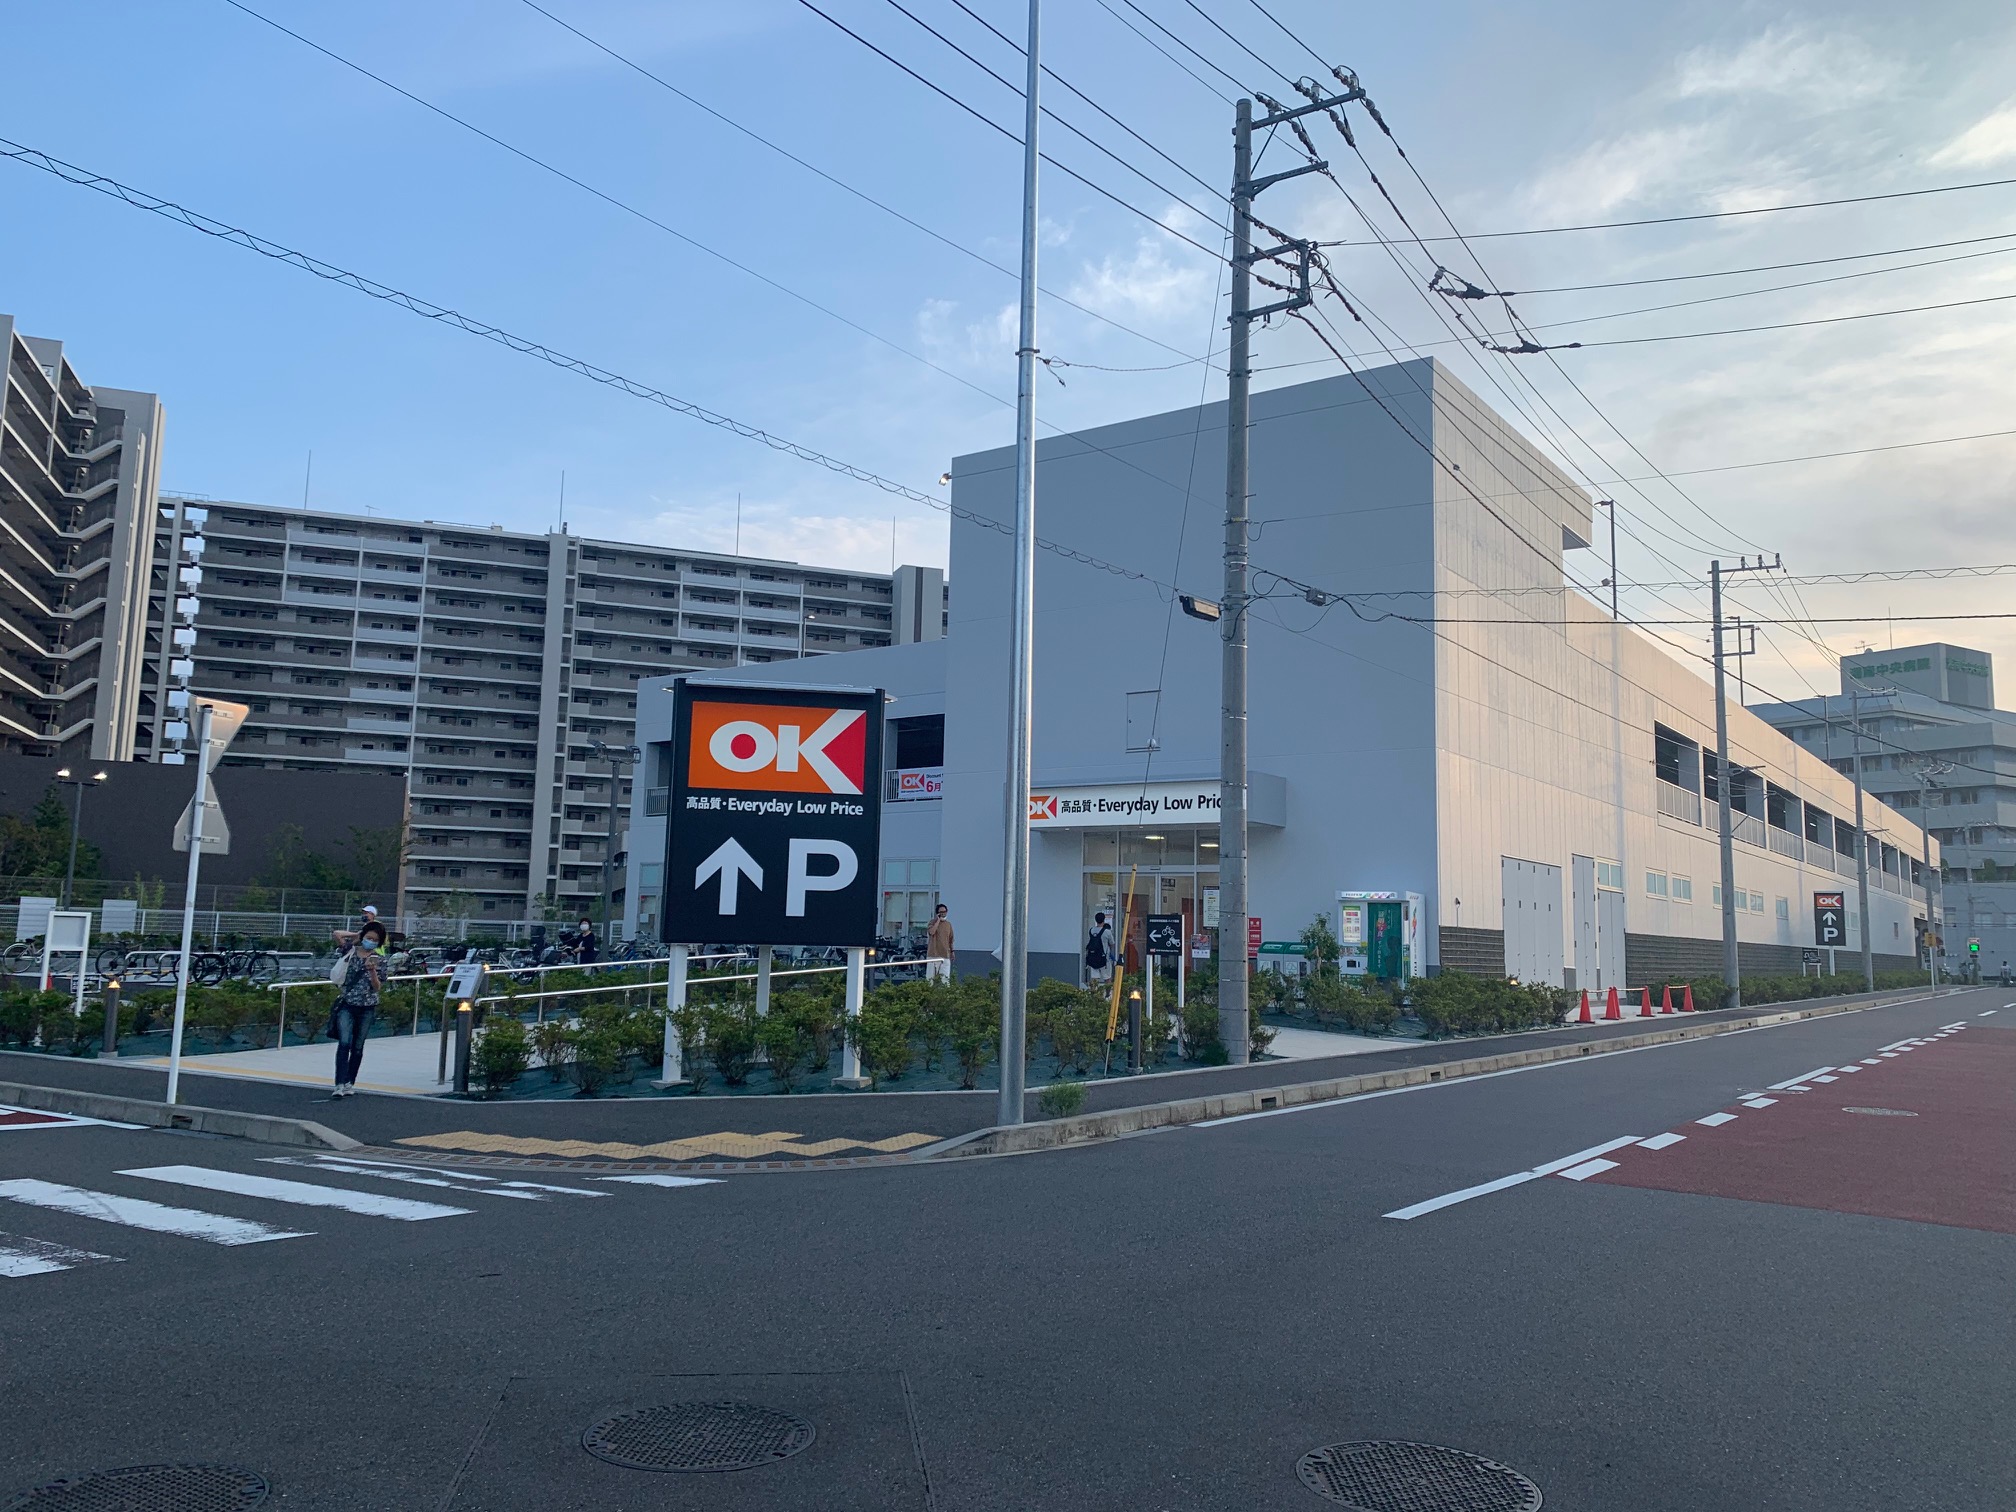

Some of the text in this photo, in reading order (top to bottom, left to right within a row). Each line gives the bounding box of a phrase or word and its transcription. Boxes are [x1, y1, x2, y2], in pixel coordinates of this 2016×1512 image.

[709, 709, 867, 795] OK
[903, 773, 925, 790] OK
[796, 801, 827, 815] Low
[830, 801, 864, 816] Price
[1163, 795, 1193, 811] Low
[1198, 793, 1222, 809] Pric
[785, 838, 859, 917] P
[1818, 895, 1841, 907] OK
[1823, 927, 1839, 942] P
